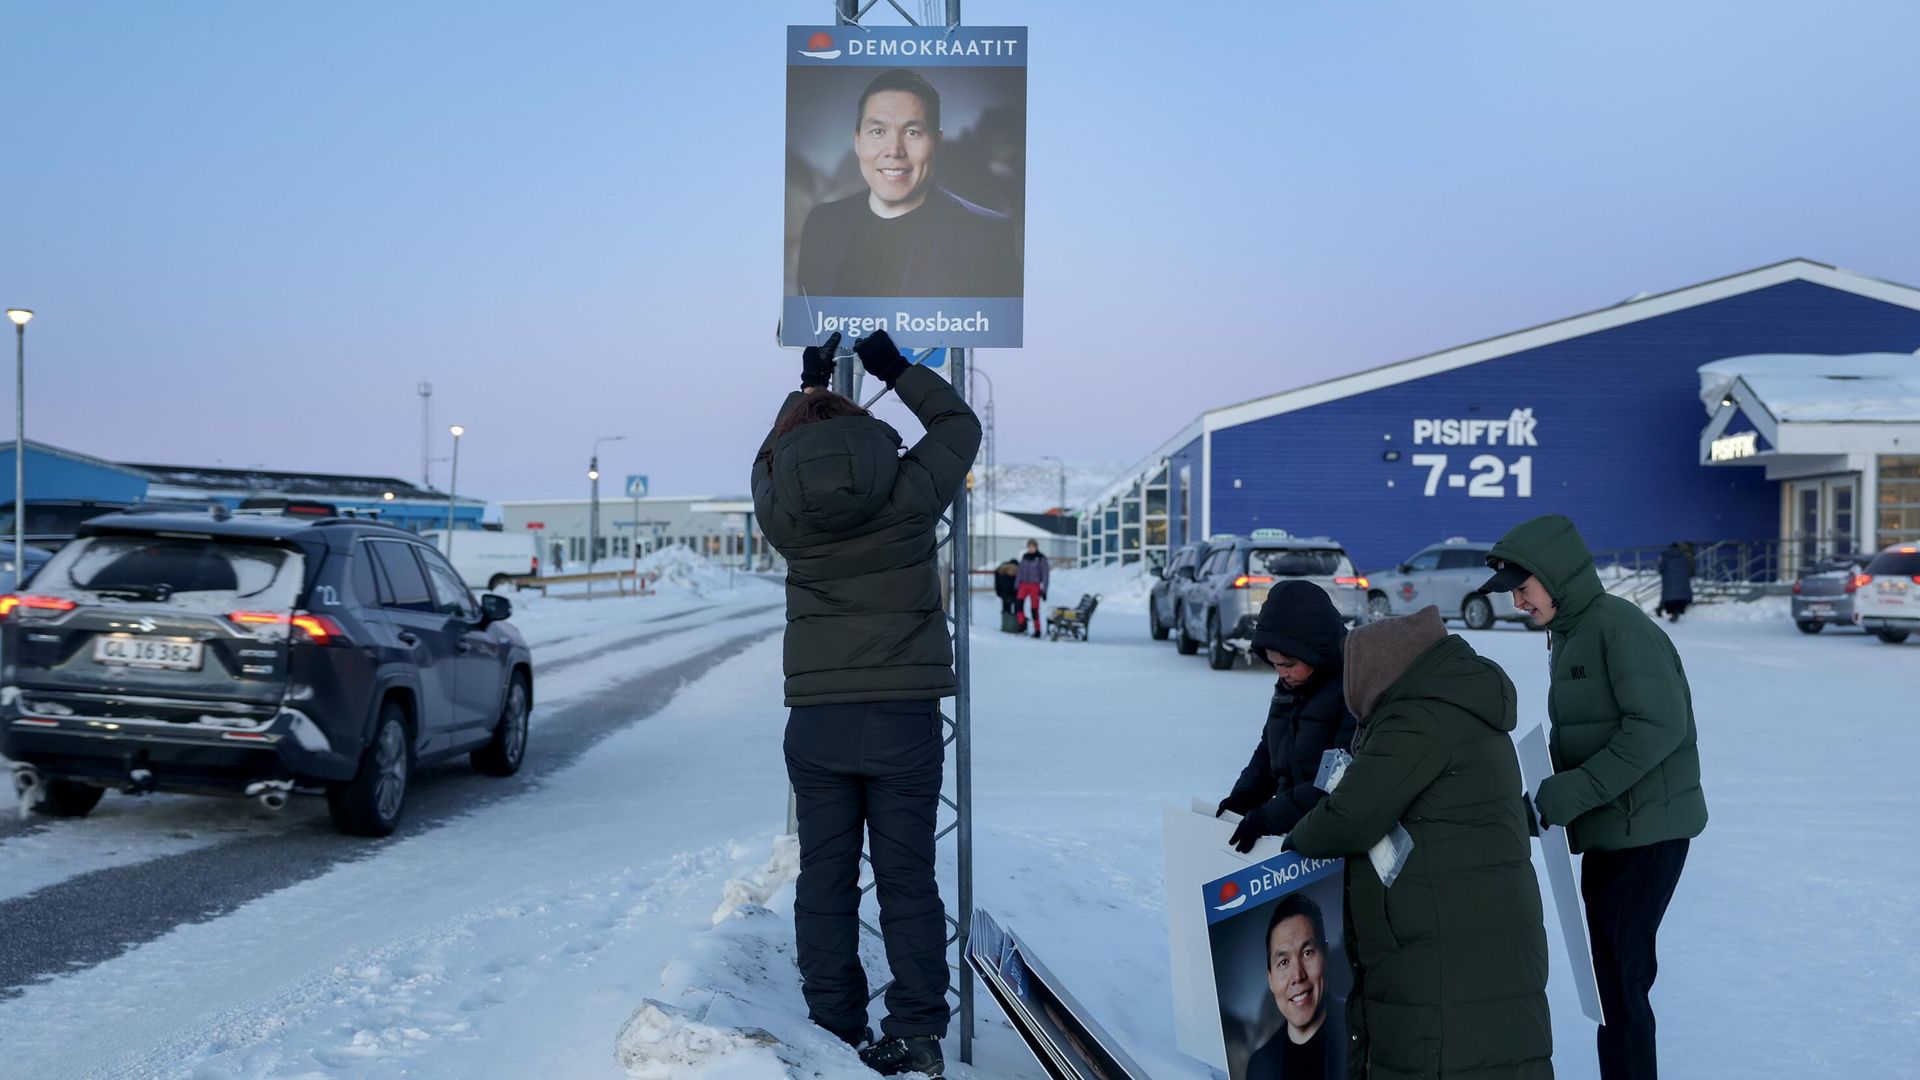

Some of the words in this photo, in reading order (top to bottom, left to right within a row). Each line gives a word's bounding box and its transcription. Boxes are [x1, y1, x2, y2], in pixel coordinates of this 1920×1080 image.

[848, 40, 1017, 56] DEMOKRAATIT
[815, 311, 888, 337] Jørgen
[896, 311, 988, 332] Rosbach
[1413, 409, 1538, 446] PISIFFIK
[1412, 454, 1532, 498] 7-21
[104, 641, 126, 658] GL
